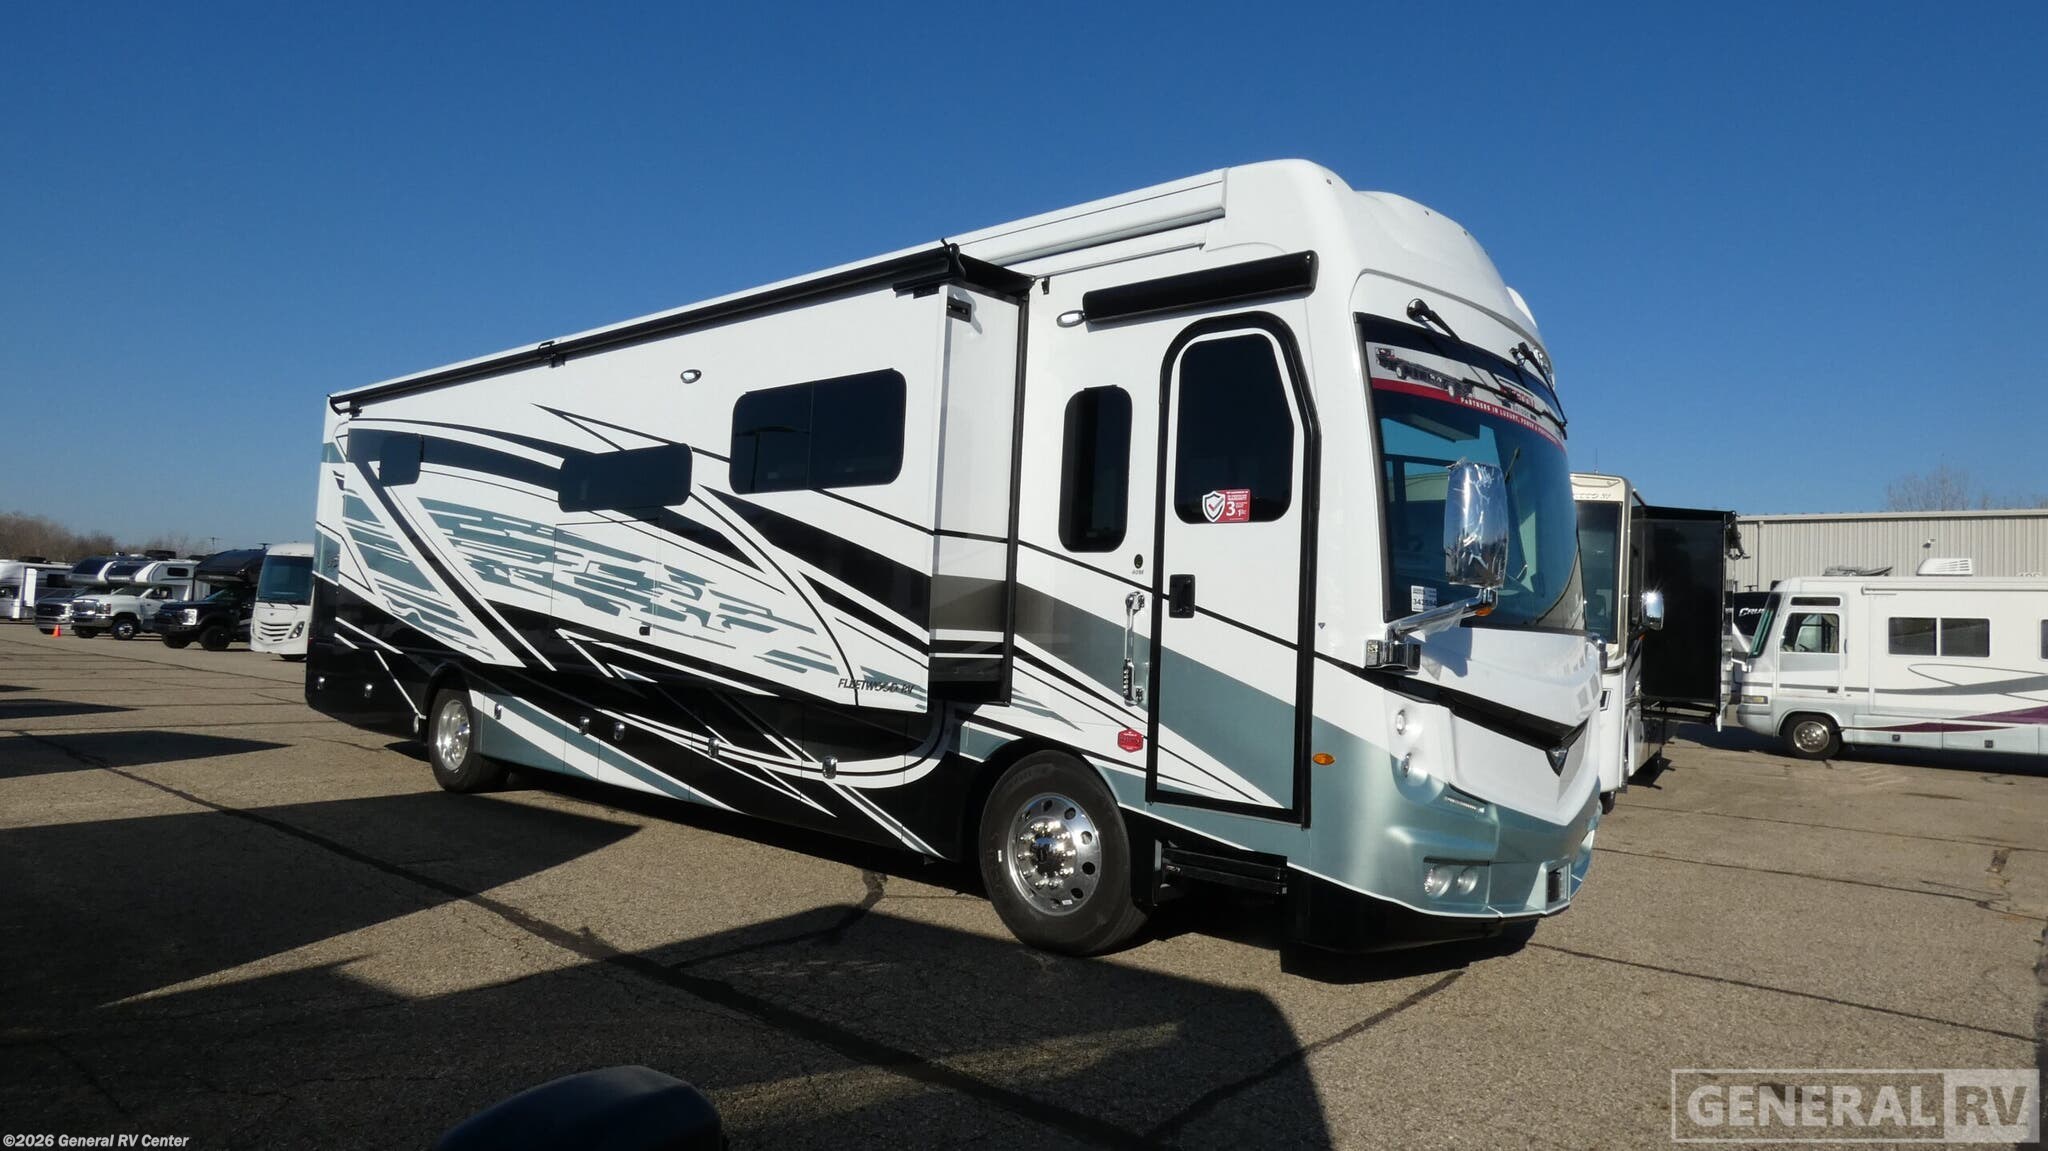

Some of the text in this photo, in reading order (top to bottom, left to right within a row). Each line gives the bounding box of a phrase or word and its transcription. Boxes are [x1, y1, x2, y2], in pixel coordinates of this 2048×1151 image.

[1460, 397, 1491, 411] PARTNERS
[1226, 501, 1236, 516] 3
[837, 678, 899, 693] FLEETWOOD
